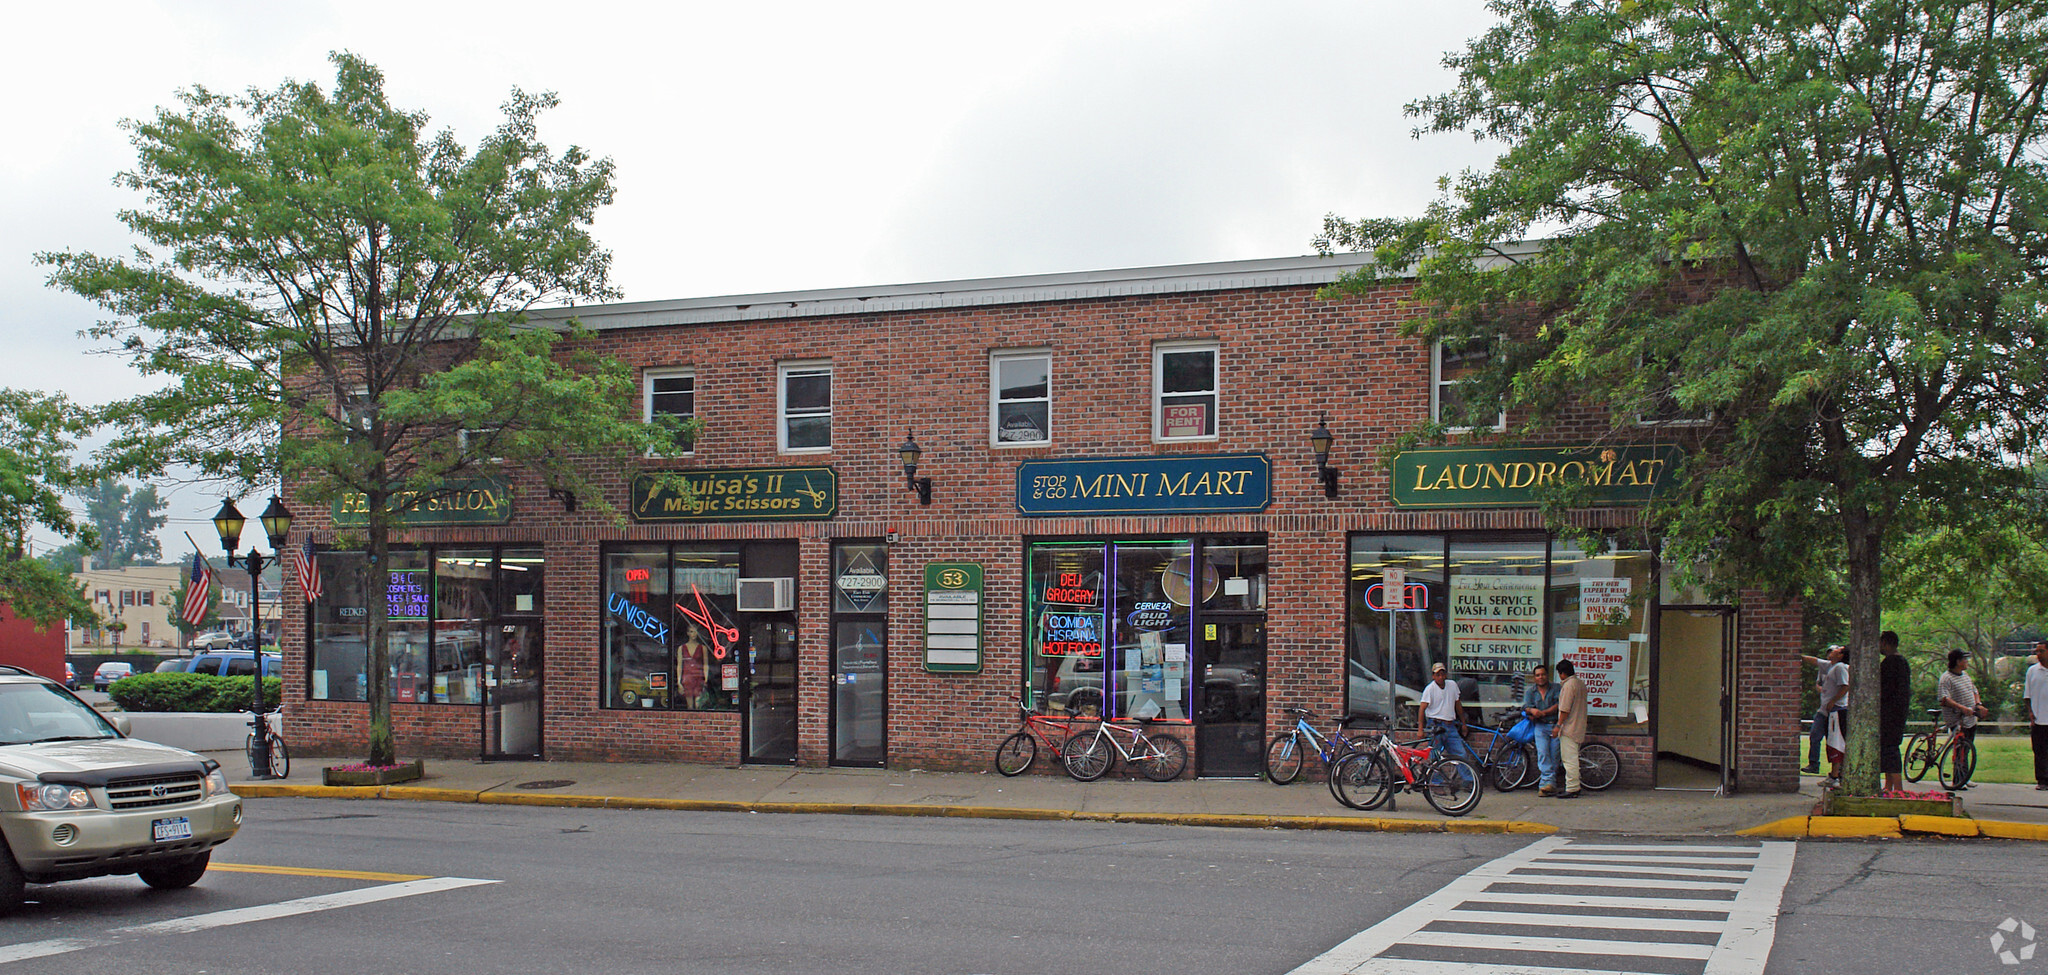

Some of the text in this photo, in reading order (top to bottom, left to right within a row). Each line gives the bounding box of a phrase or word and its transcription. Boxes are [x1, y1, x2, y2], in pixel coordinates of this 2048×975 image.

[1170, 407, 1198, 417] FOR
[1166, 417, 1202, 427] RENT
[1412, 459, 1664, 491] LAUNDROMAT
[681, 475, 785, 496] uisa's II
[1033, 475, 1067, 488] STOP
[1070, 471, 1253, 498] MINI MART
[1033, 487, 1067, 499] & GO
[340, 489, 499, 513] BEUTY SALON
[664, 496, 801, 515] Magic Scissors
[391, 572, 399, 584] B
[407, 572, 414, 584] C
[625, 568, 649, 581] OPEN
[942, 572, 963, 585] 53
[1060, 573, 1082, 587] DELI
[1389, 571, 1398, 580] NO
[841, 577, 883, 587] 727-2900
[1046, 588, 1094, 603] GROCERY
[1458, 595, 1534, 605] FULL SERVICE
[1134, 602, 1172, 610] CERVEZA
[1454, 606, 1537, 616] WASH & FOLD
[1586, 605, 1607, 613] ONLY
[608, 592, 668, 645] UNISEX
[1049, 615, 1094, 629] COMIDA
[1139, 612, 1168, 620] BUD
[1047, 629, 1098, 642] HISPANA
[1453, 624, 1538, 635] DRY CLEANING
[1042, 641, 1101, 656] HOT FOOD
[1460, 643, 1532, 654] SELF SERVICE
[1562, 653, 1623, 662] WEEKEND
[1452, 659, 1494, 671] PARKING
[1498, 660, 1509, 671] IN
[1571, 661, 1613, 669] HOURS
